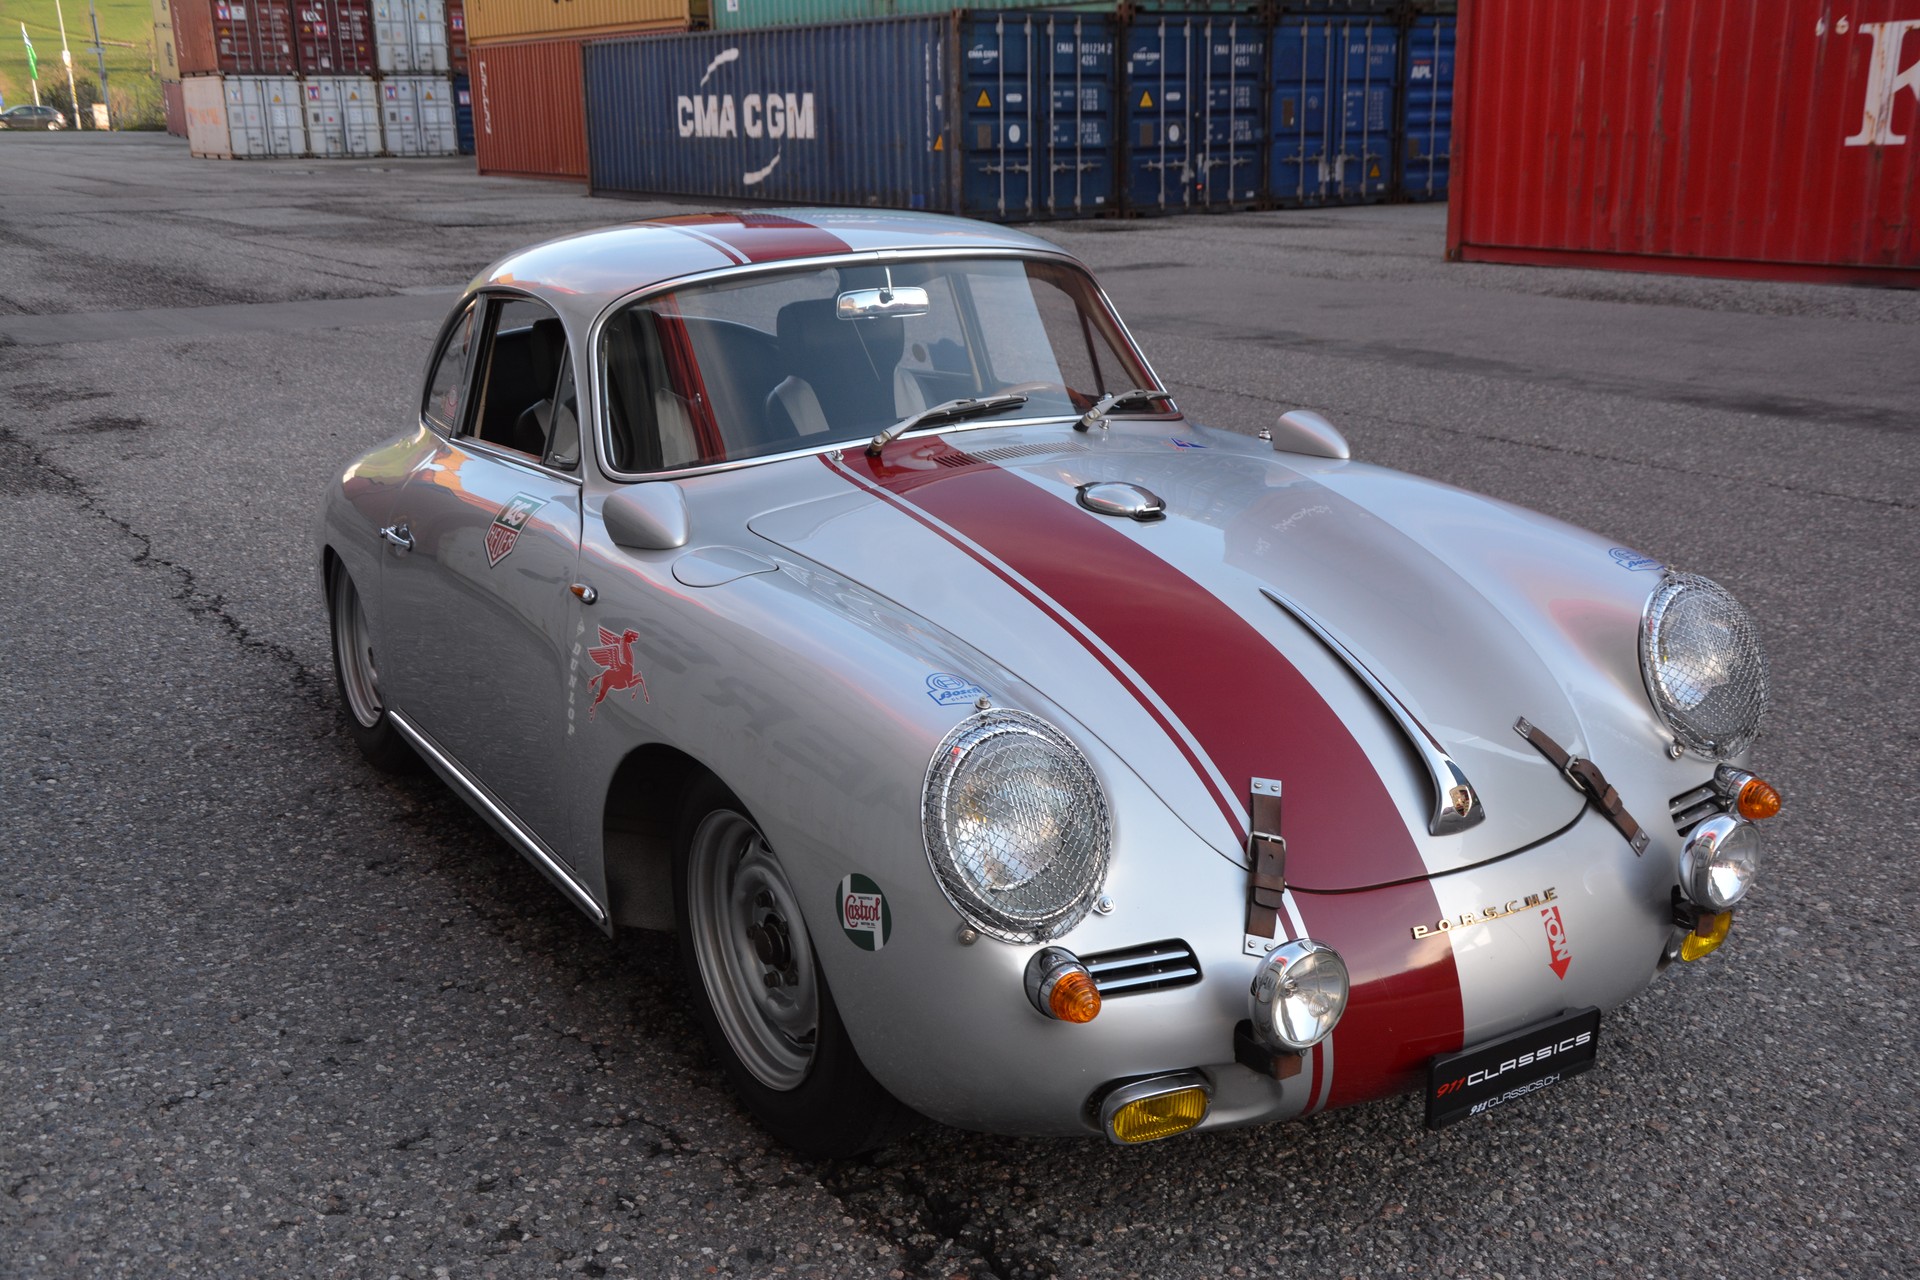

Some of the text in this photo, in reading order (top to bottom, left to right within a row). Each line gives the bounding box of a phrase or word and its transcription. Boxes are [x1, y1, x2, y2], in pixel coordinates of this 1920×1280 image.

[1411, 65, 1432, 79] APL
[677, 92, 815, 139] CMA CGM
[502, 499, 533, 526] TAG
[487, 526, 516, 558] HEUER
[567, 642, 582, 736] DUNLOP
[939, 687, 981, 701] Bosch
[845, 894, 880, 928] Castrol
[1411, 887, 1558, 940] PORSCHE
[1543, 906, 1572, 962] TOW
